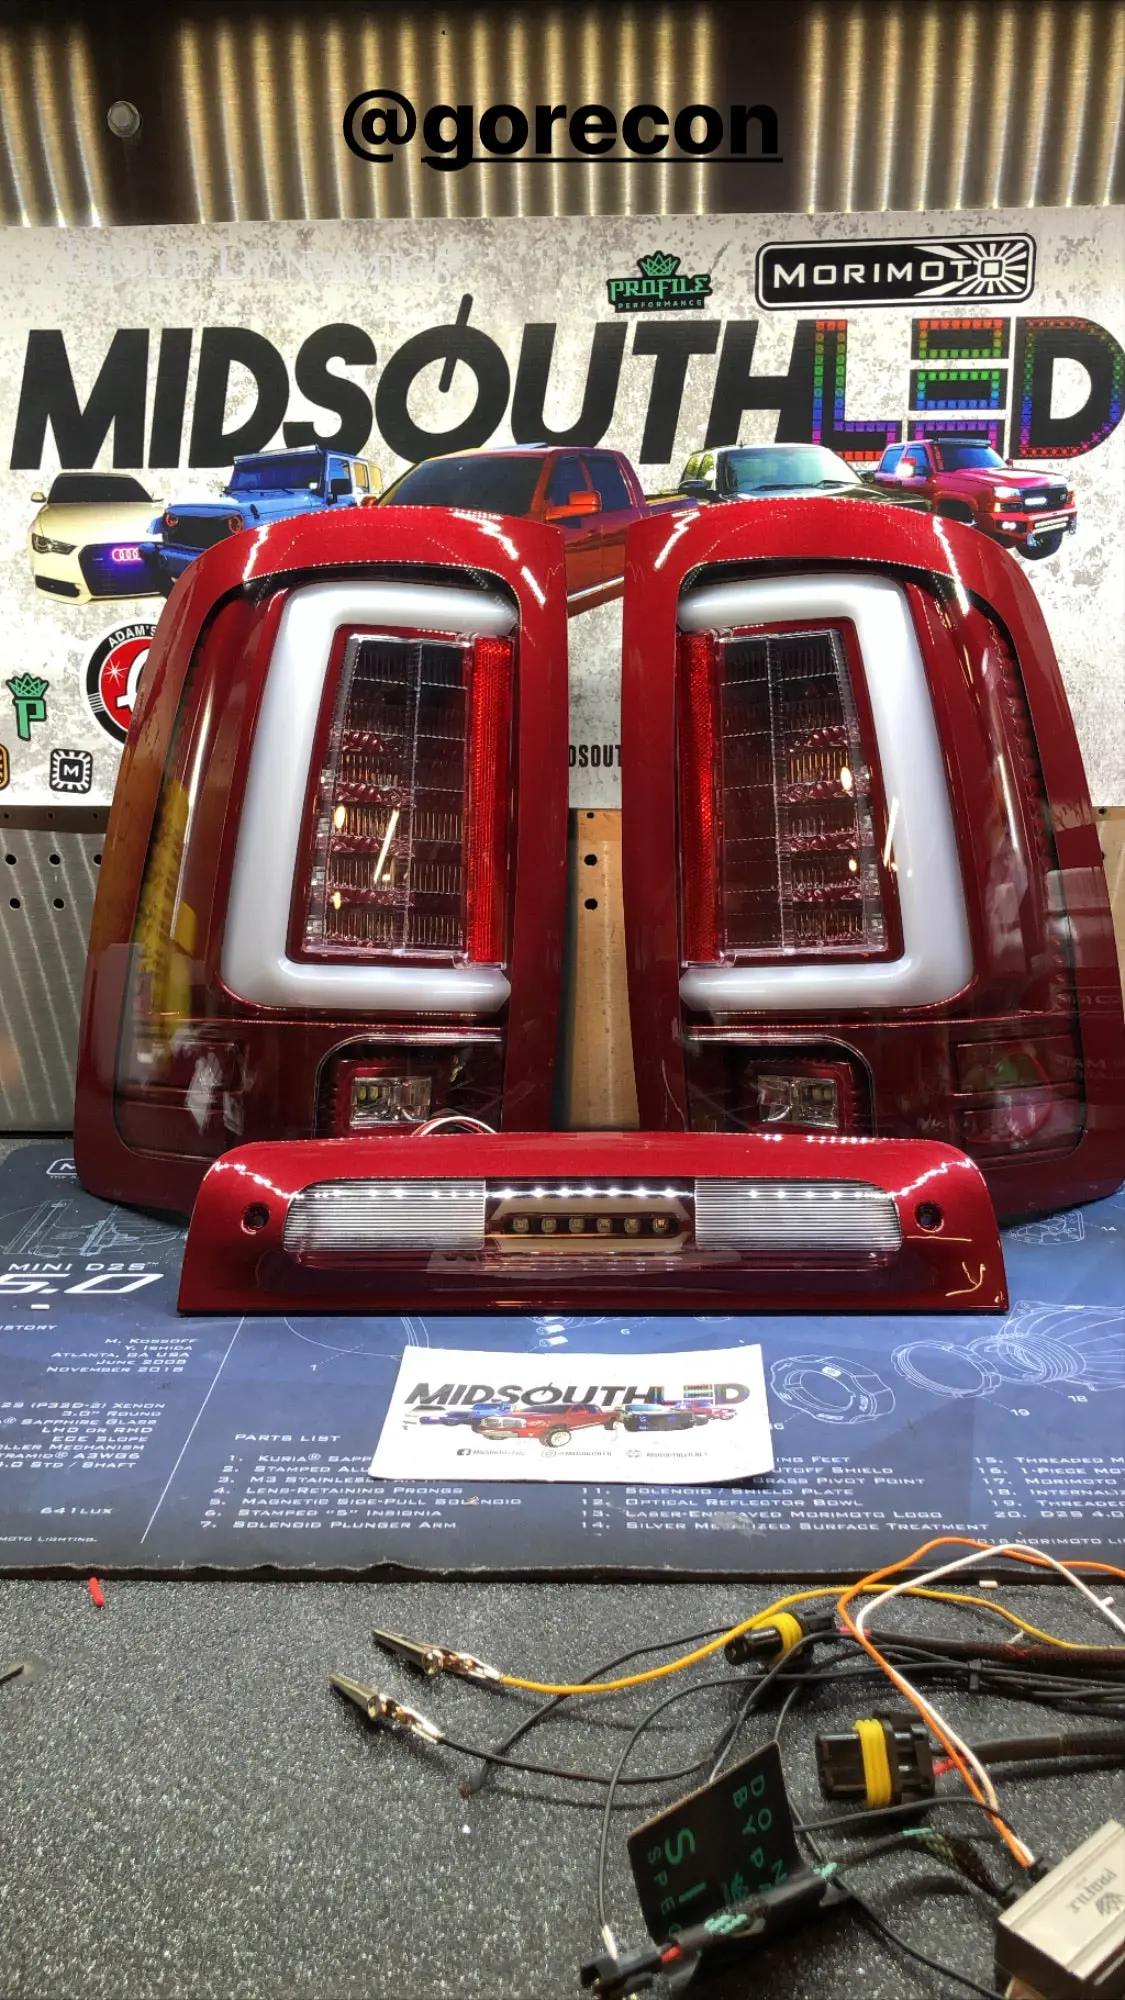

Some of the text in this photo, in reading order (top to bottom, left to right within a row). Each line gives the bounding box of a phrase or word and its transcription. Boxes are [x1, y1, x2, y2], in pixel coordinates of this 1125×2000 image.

[774, 257, 1007, 289] MORIMOTO
[610, 275, 710, 303] PROFILE
[617, 299, 704, 310] PERFORMANCE
[8, 1263, 73, 1272] MINI
[235, 1433, 341, 1442] PARTS LIST
[49, 1443, 145, 1451] MECHANISM
[811, 1455, 850, 1463] FEET
[974, 1456, 1004, 1464] 15.
[1013, 1456, 1104, 1464] THREADED
[222, 1465, 239, 1473] 2.
[254, 1465, 332, 1473] STAMPED
[832, 1466, 894, 1474] SHIELD
[250, 1475, 277, 1484] M3
[753, 1476, 809, 1485] BRASS
[816, 1476, 865, 1485] PIVOT
[874, 1476, 925, 1485] POINT
[982, 1477, 1013, 1485] 17.
[1024, 1477, 1118, 1485] MORIMOTO
[213, 1486, 464, 1494] 4. LENS-RETAINING PRONGS
[582, 1487, 611, 1495] 11.
[626, 1487, 712, 1495] SOLENOID
[801, 1487, 854, 1495] PLATE
[986, 1488, 1017, 1496] 18.
[242, 1497, 329, 1505] MAGNETIC
[337, 1497, 427, 1505] SIDE-PULL
[582, 1498, 864, 1507] 12. OPTICAL REFLECTOR BOWL
[992, 1499, 1023, 1507] 19.
[205, 1509, 222, 1517] 6.
[238, 1508, 318, 1517] STAMPED
[367, 1509, 442, 1517] INSIGNIA
[582, 1510, 611, 1518] 13.
[790, 1511, 886, 1519] MORIMOTO
[893, 1511, 943, 1519] LOGO
[994, 1510, 1028, 1518] 20.
[200, 1520, 457, 1529] 7. SOLENOID PLUNGER ARM
[582, 1521, 611, 1529] 14.
[626, 1521, 687, 1530] SILVER
[799, 1522, 880, 1530] SURFACE
[885, 1522, 990, 1531] TREATMENT
